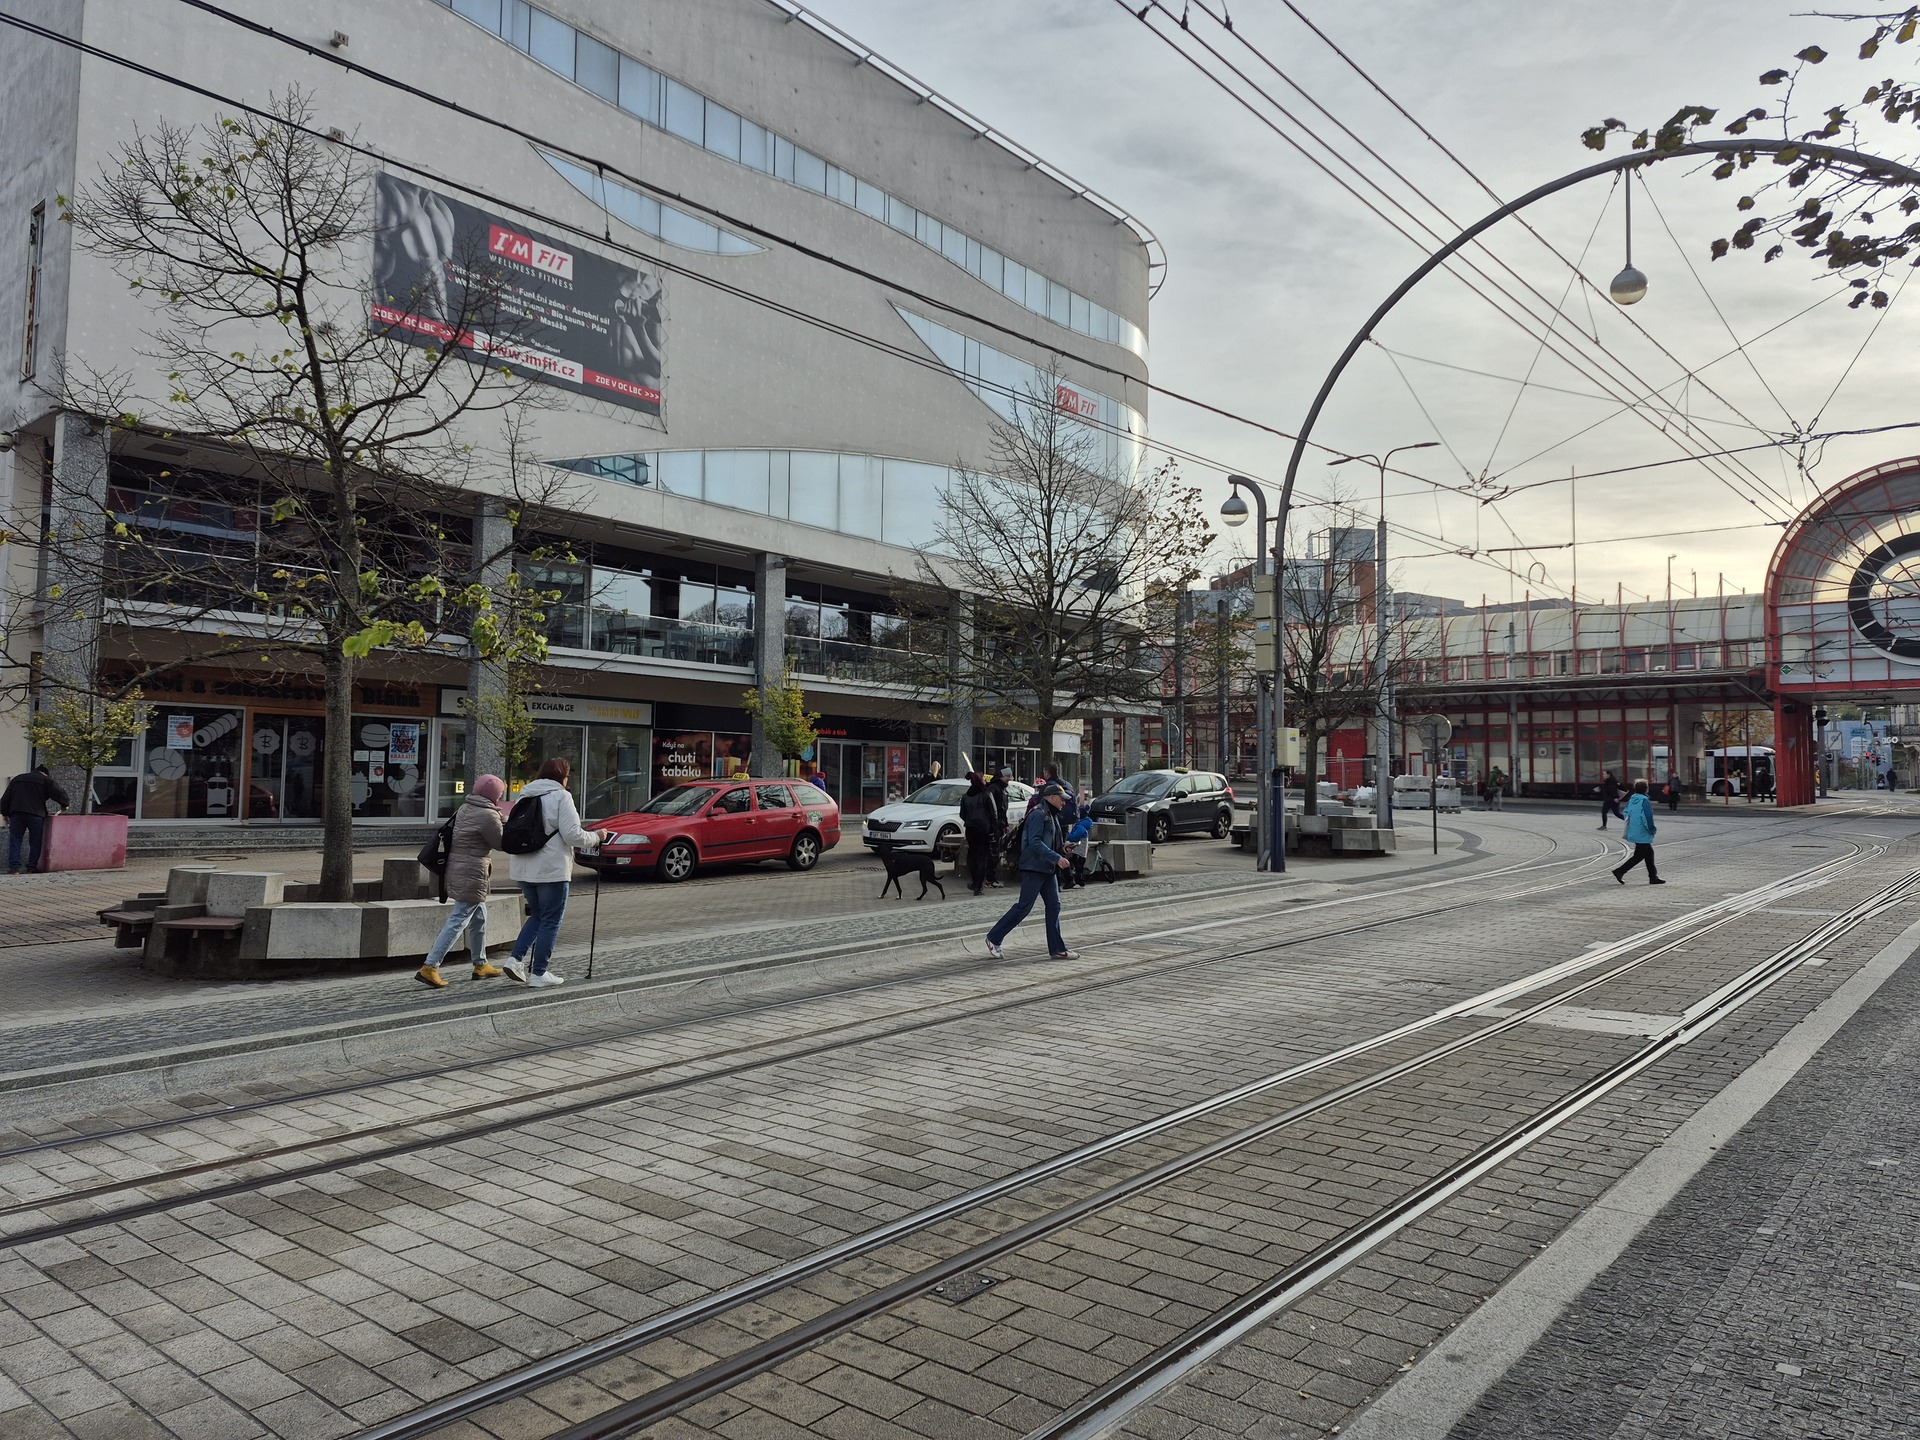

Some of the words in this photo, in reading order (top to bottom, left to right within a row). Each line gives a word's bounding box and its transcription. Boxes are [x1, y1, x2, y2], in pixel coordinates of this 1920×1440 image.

[494, 232, 528, 259] I'M
[538, 249, 568, 271] FIT
[489, 253, 535, 277] WELLNESS
[539, 272, 573, 291] FITNESS
[549, 299, 565, 311] zóna
[572, 306, 599, 320] Aerobní
[600, 316, 610, 325] sál
[418, 320, 436, 332] LBC
[540, 315, 567, 332] Masáže
[551, 309, 563, 320] Bio
[564, 314, 585, 327] sauna
[591, 323, 607, 334] Pára
[482, 340, 575, 377] www.imfit.cz
[595, 375, 610, 386] ZDE
[611, 380, 617, 388] V
[618, 382, 628, 392] OC
[629, 385, 642, 396] LBC
[1081, 400, 1097, 416] FIT
[531, 698, 575, 712] EXCHANGE
[662, 741, 677, 750] Když
[1010, 732, 1030, 746] LBC
[668, 751, 696, 763] chuti
[661, 765, 701, 777] tabáku
